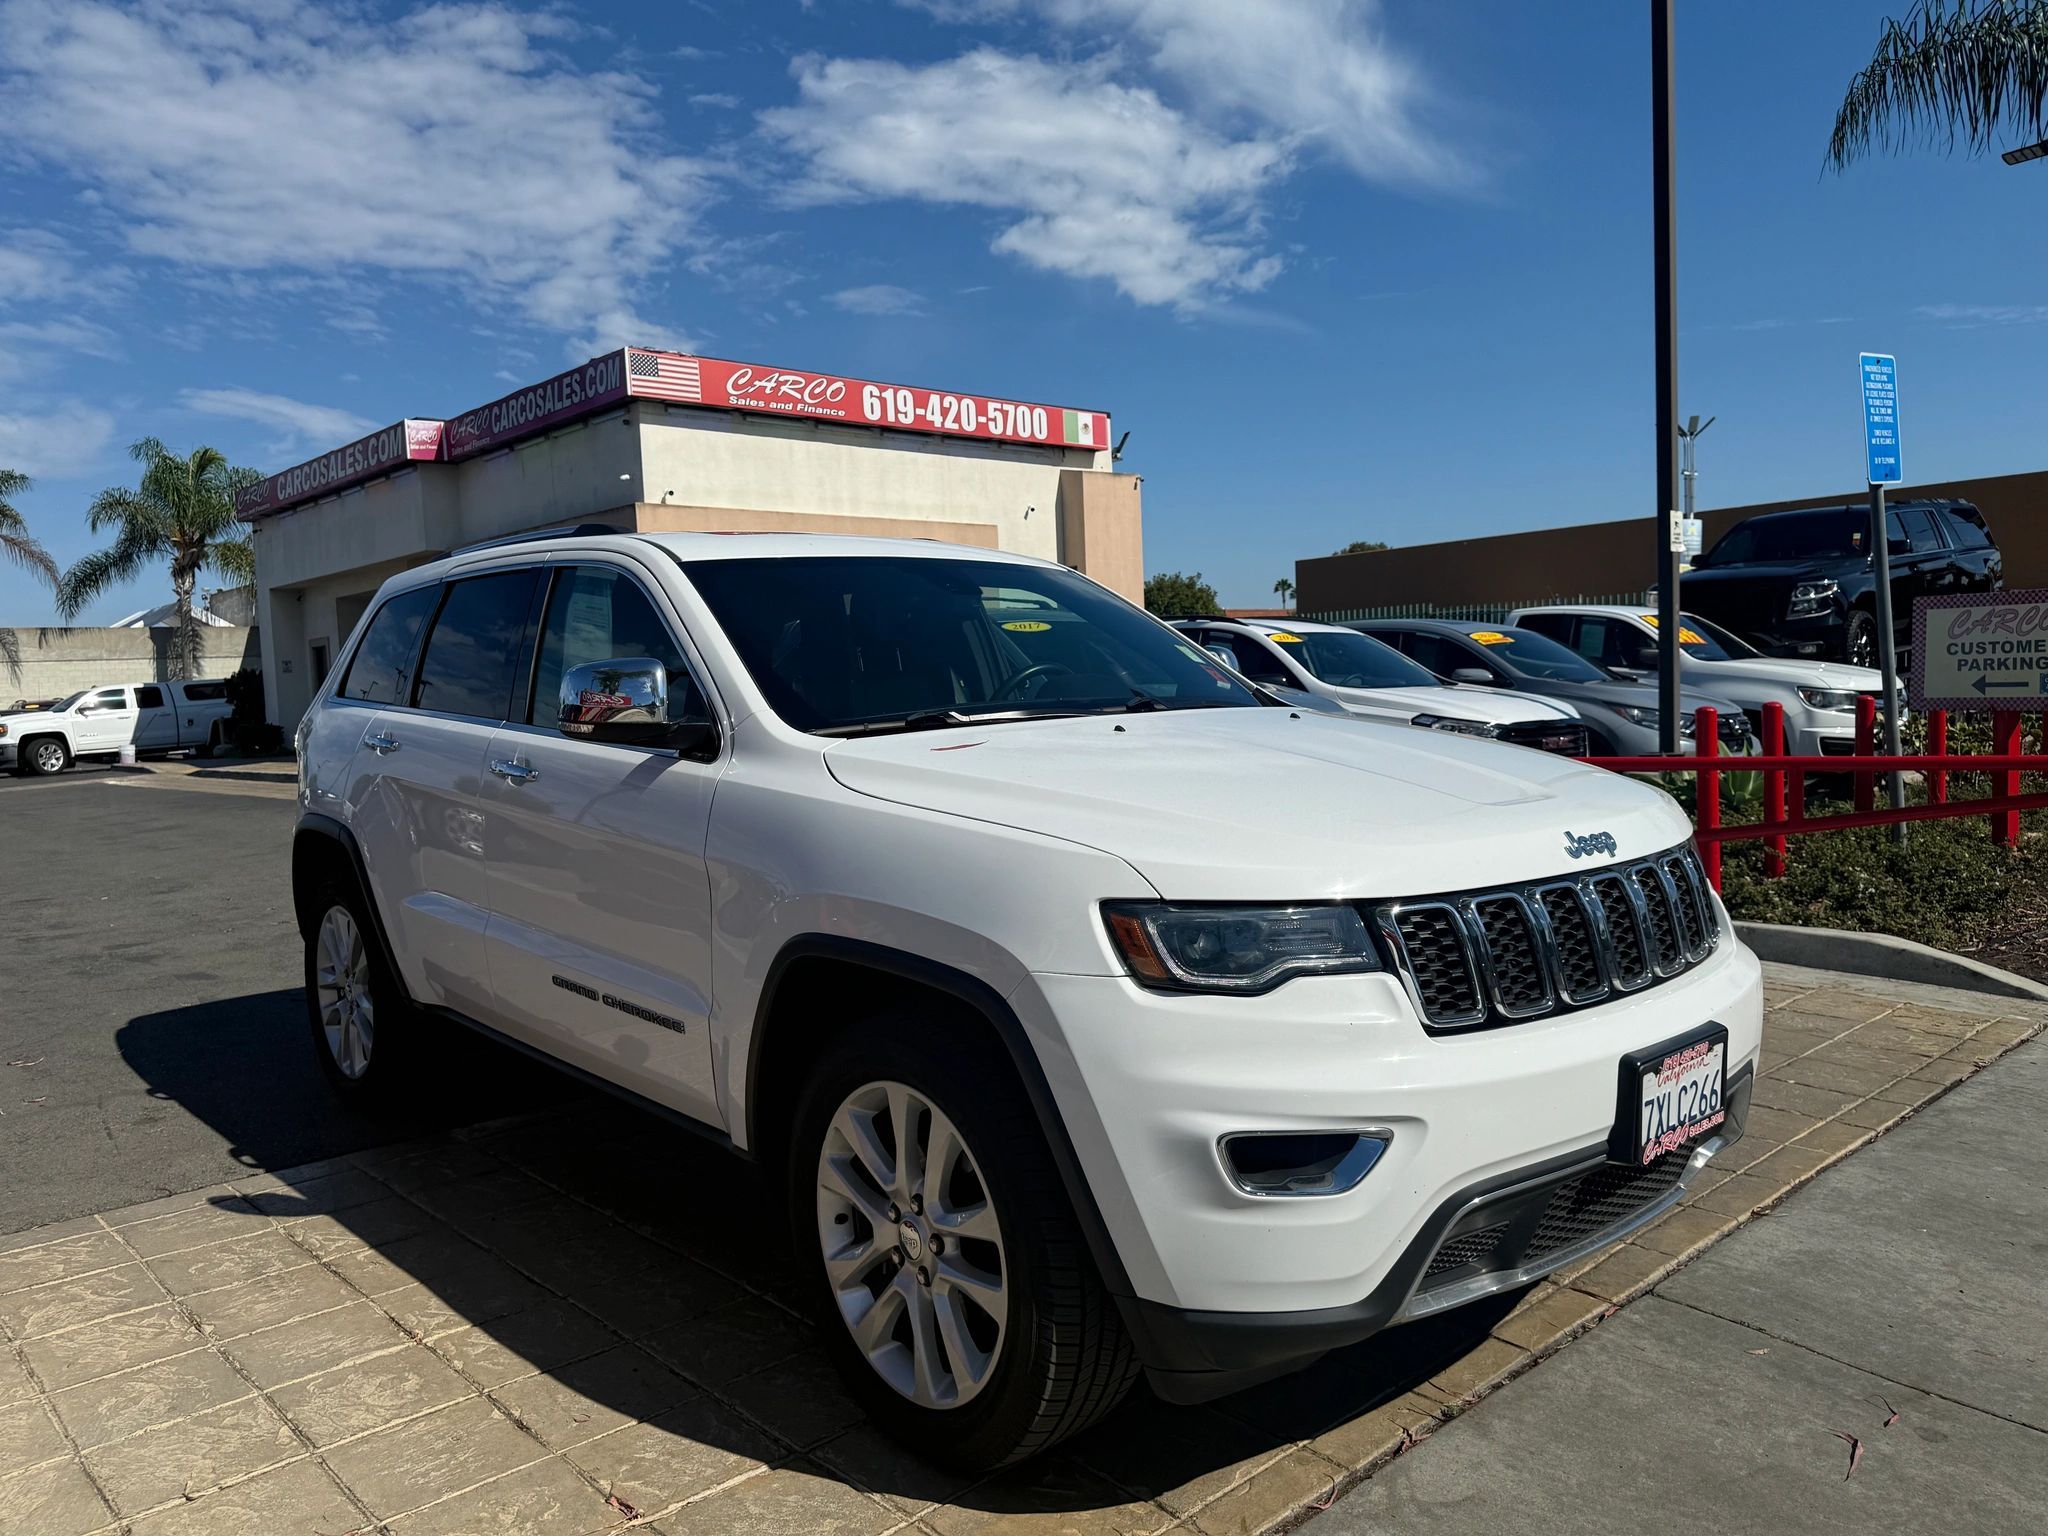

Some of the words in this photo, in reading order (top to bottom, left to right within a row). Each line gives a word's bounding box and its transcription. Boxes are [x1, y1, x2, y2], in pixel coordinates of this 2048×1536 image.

[491, 356, 620, 434] CARCOSALES.COM
[726, 368, 846, 404] CARCO
[729, 395, 765, 408] Sales
[769, 401, 793, 411] and
[797, 403, 846, 417] Finance
[862, 384, 1048, 440] 619-420-5700
[410, 430, 438, 443] CARCO
[450, 408, 490, 445] CARCO
[277, 426, 402, 501] CARCOSALES.COM
[237, 480, 270, 510] CARCO
[1011, 623, 1041, 631] 2017
[1946, 640, 2047, 656] CUSTOME
[1957, 656, 2048, 672] PARKING
[1563, 830, 1617, 859] Jeep
[552, 974, 599, 1002] GRAND
[602, 992, 686, 1034] CHEROKEE
[1657, 1056, 1710, 1088] California
[1644, 1069, 1720, 1141] 7XLC266
[1689, 1110, 1725, 1137] SALES.COM
